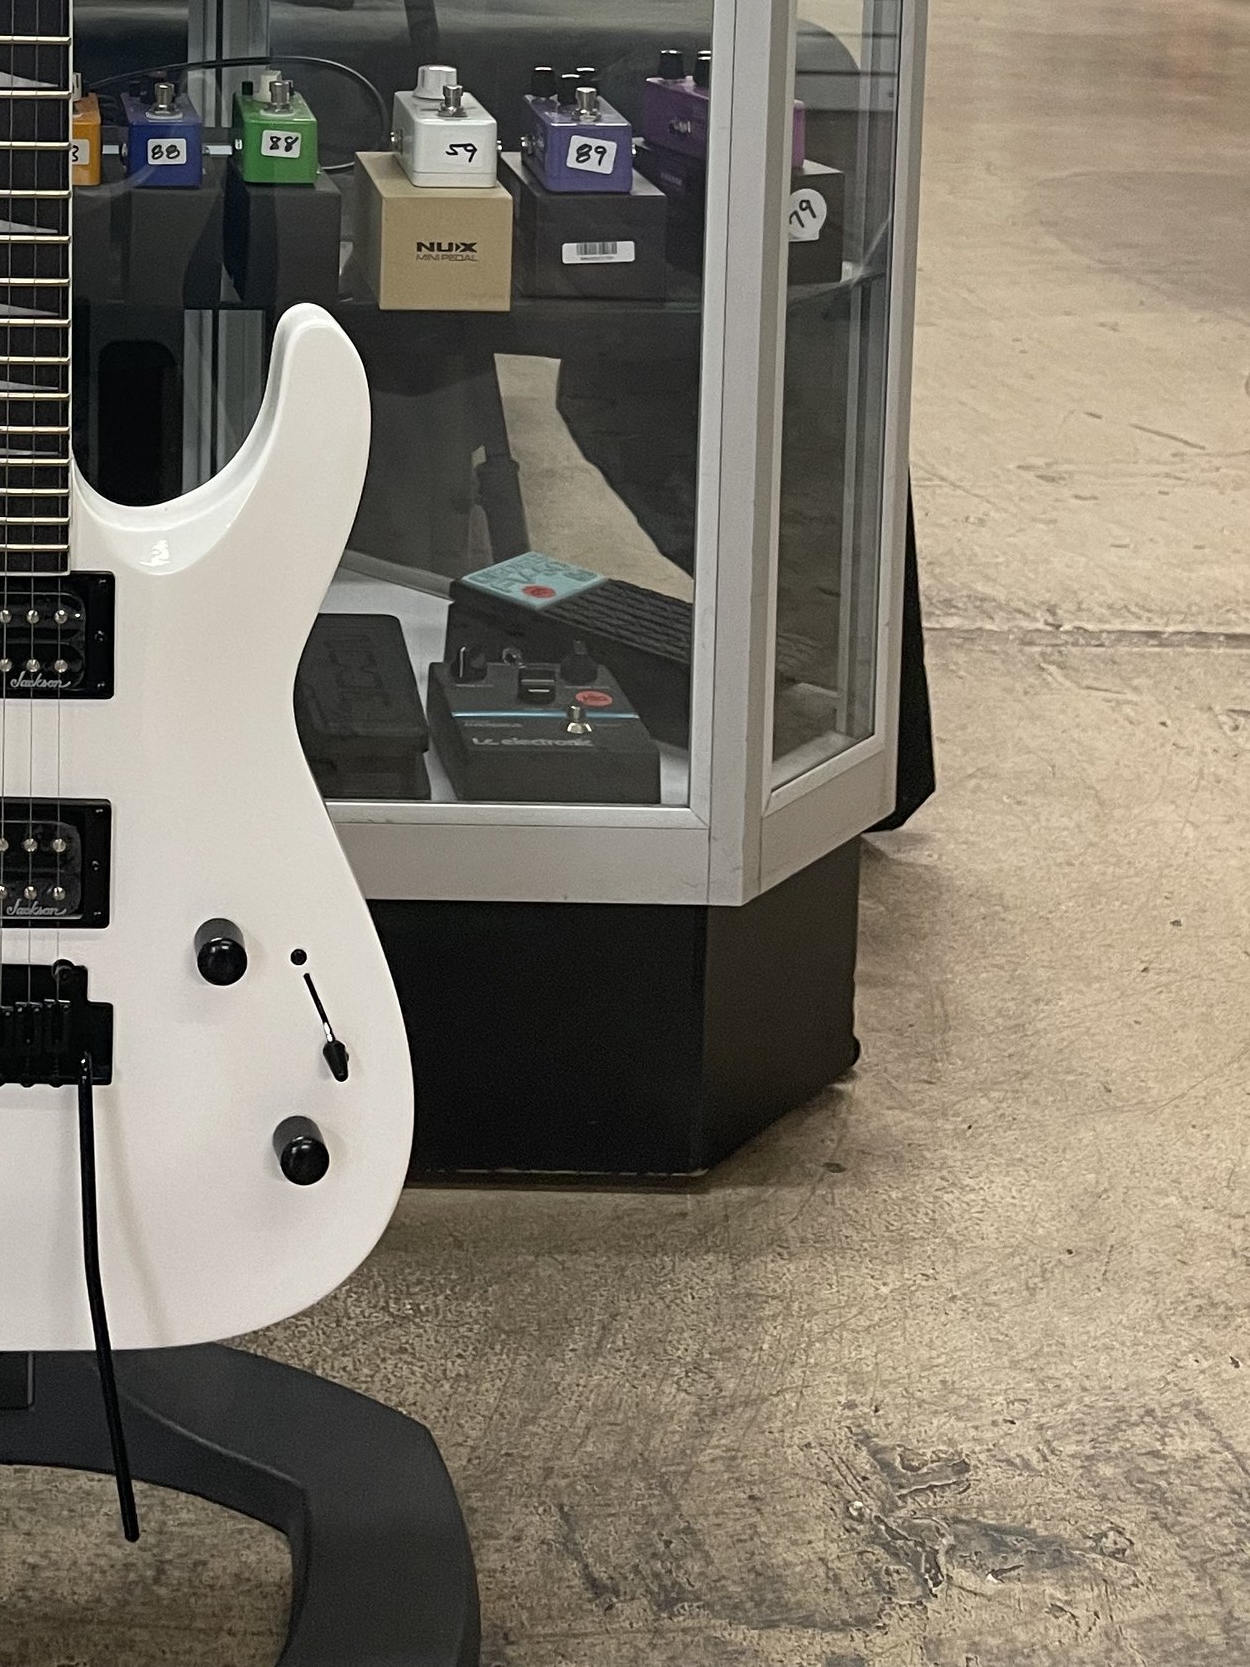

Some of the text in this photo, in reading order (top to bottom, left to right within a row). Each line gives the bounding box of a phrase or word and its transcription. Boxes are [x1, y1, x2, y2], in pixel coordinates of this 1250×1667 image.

[151, 144, 180, 160] 88
[446, 142, 478, 163] 59
[575, 143, 608, 166] 89
[416, 241, 478, 253] NUX
[416, 253, 478, 262] MINI PEDAL
[10, 670, 72, 689] Jackson
[501, 737, 594, 747] electronic
[6, 898, 67, 917] Jackson
